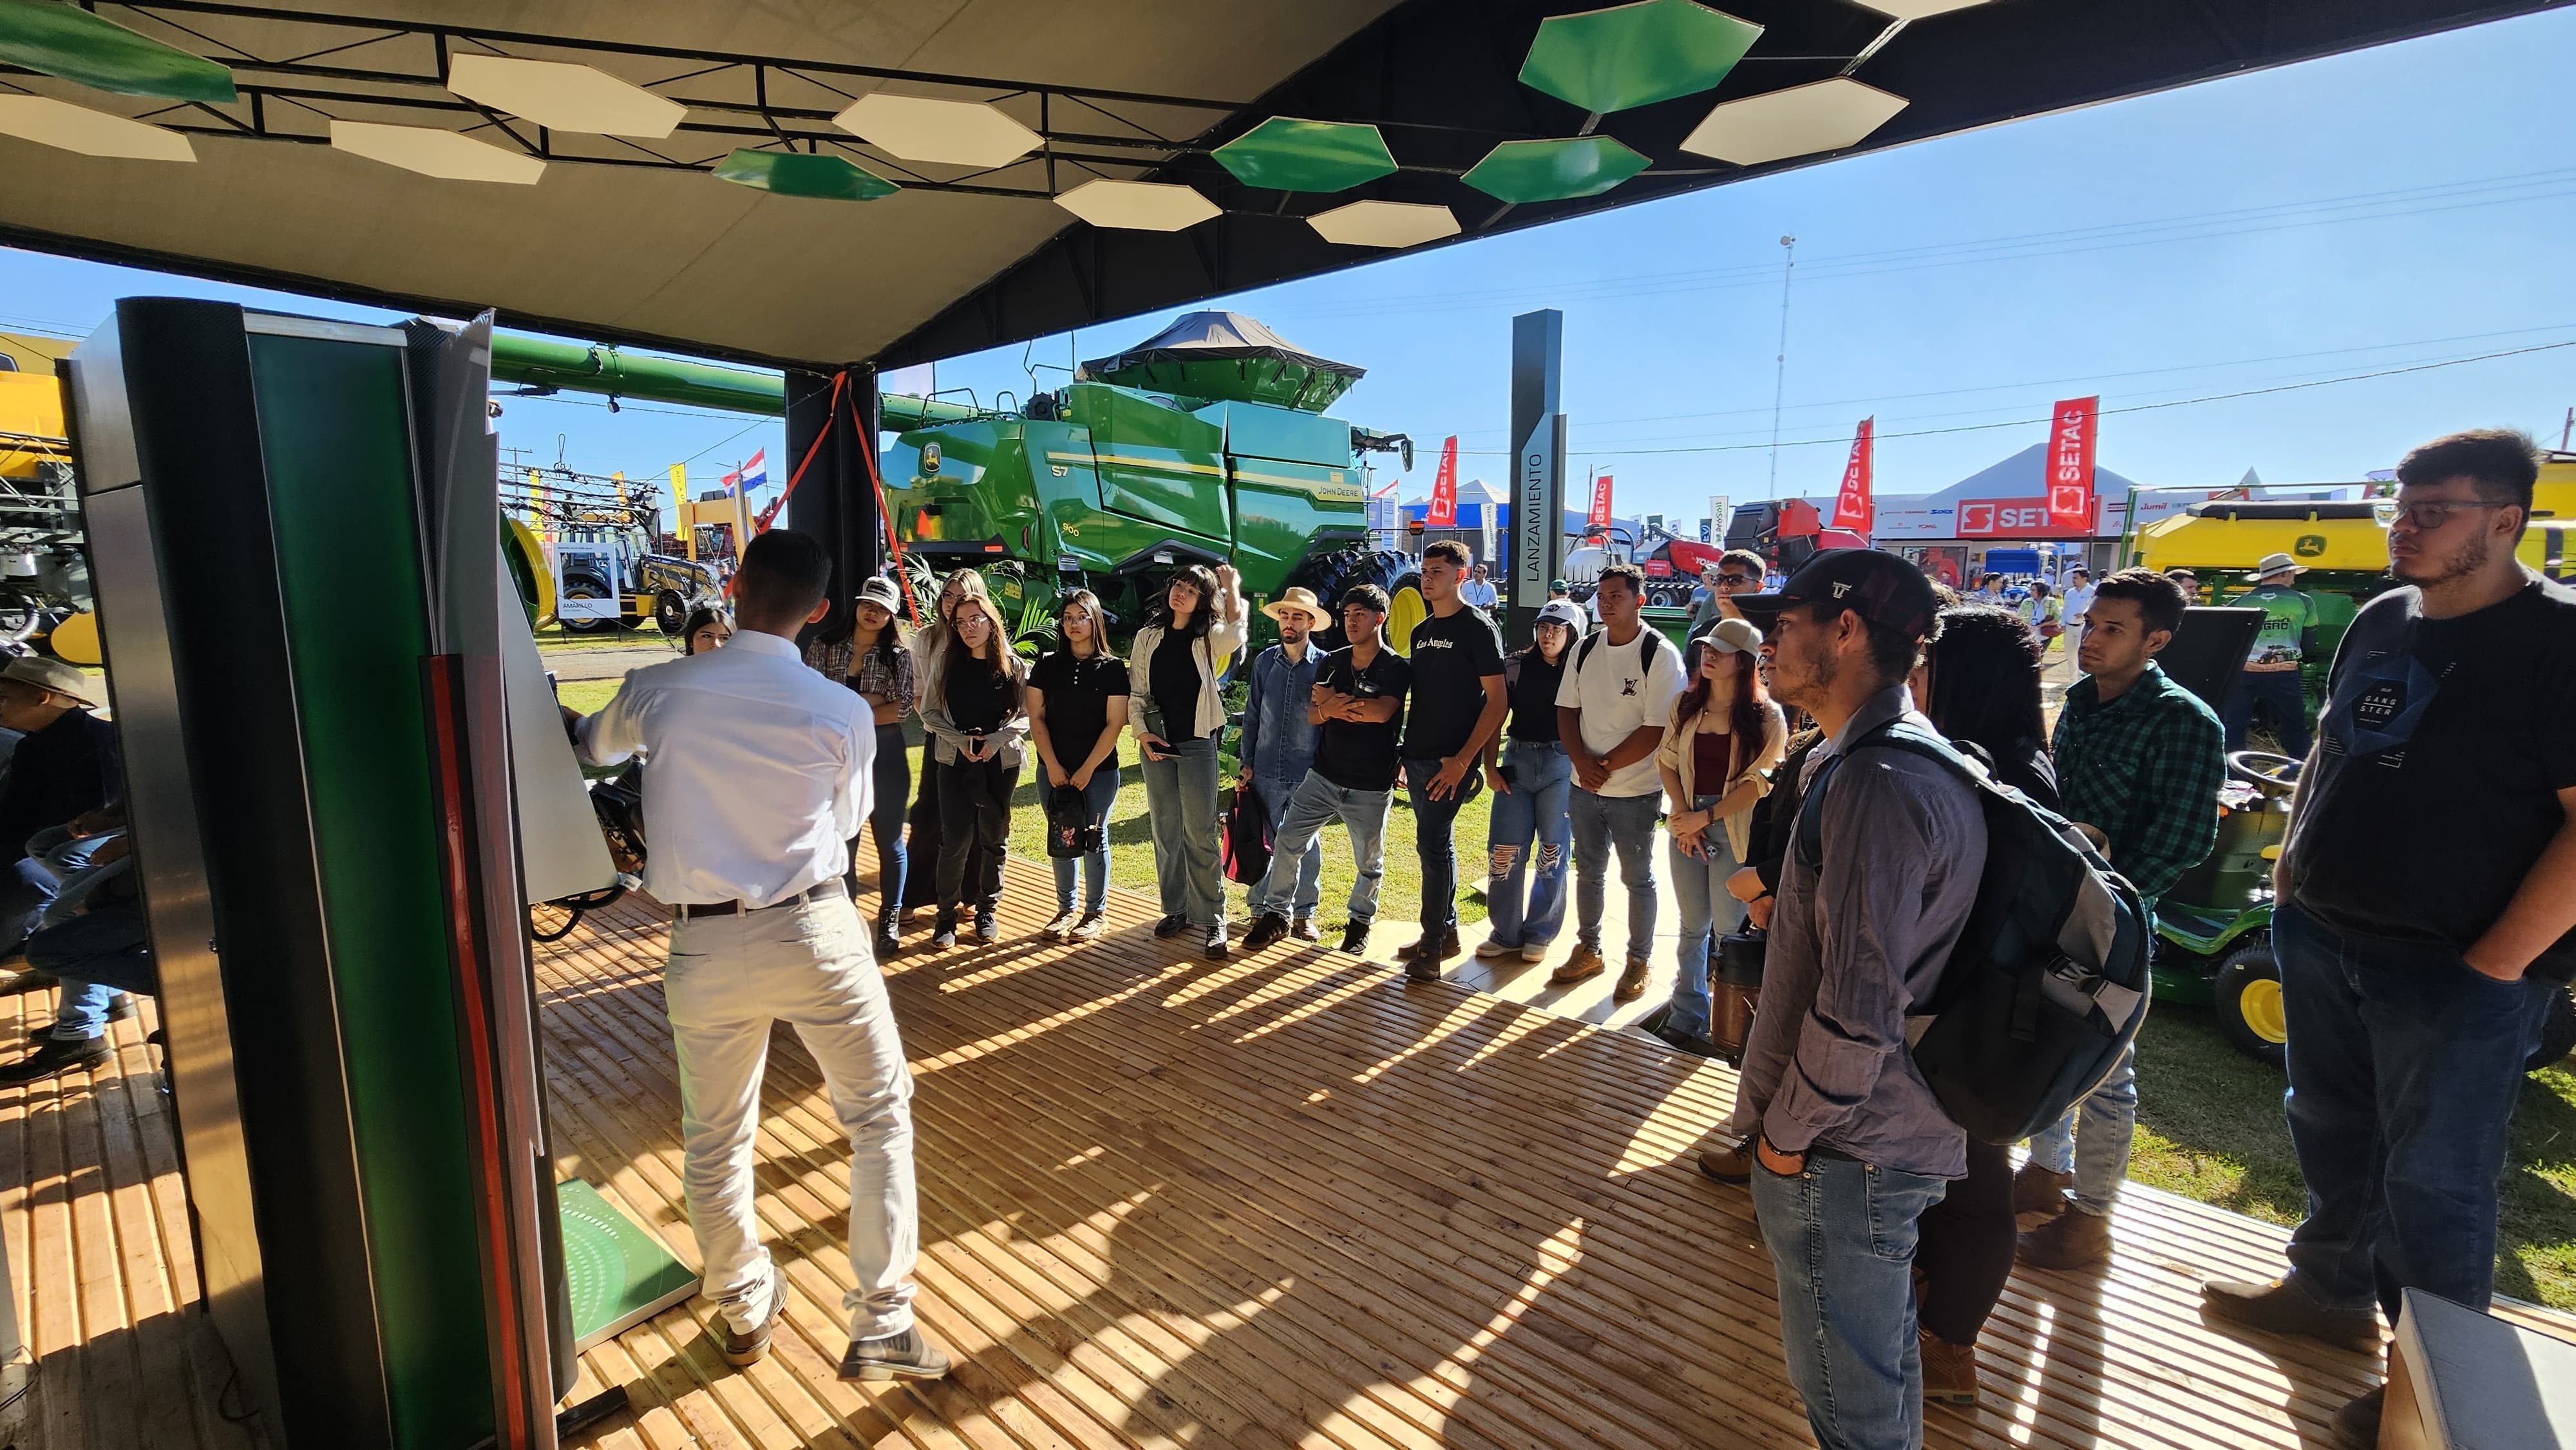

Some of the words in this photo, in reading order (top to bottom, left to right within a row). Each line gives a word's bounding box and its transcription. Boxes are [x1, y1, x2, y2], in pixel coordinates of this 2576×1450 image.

[2059, 410, 2083, 481] SETAC
[1051, 465, 1068, 477] S7
[1318, 486, 1336, 494] JOHN
[1337, 488, 1358, 496] DEERE
[1595, 483, 1606, 522] SETAC
[1527, 454, 1542, 581] LANZAMIENTO
[1999, 507, 2052, 527] SET
[1063, 523, 1079, 537] 900
[2365, 695, 2396, 705] GANG
[2360, 706, 2391, 715] STER
